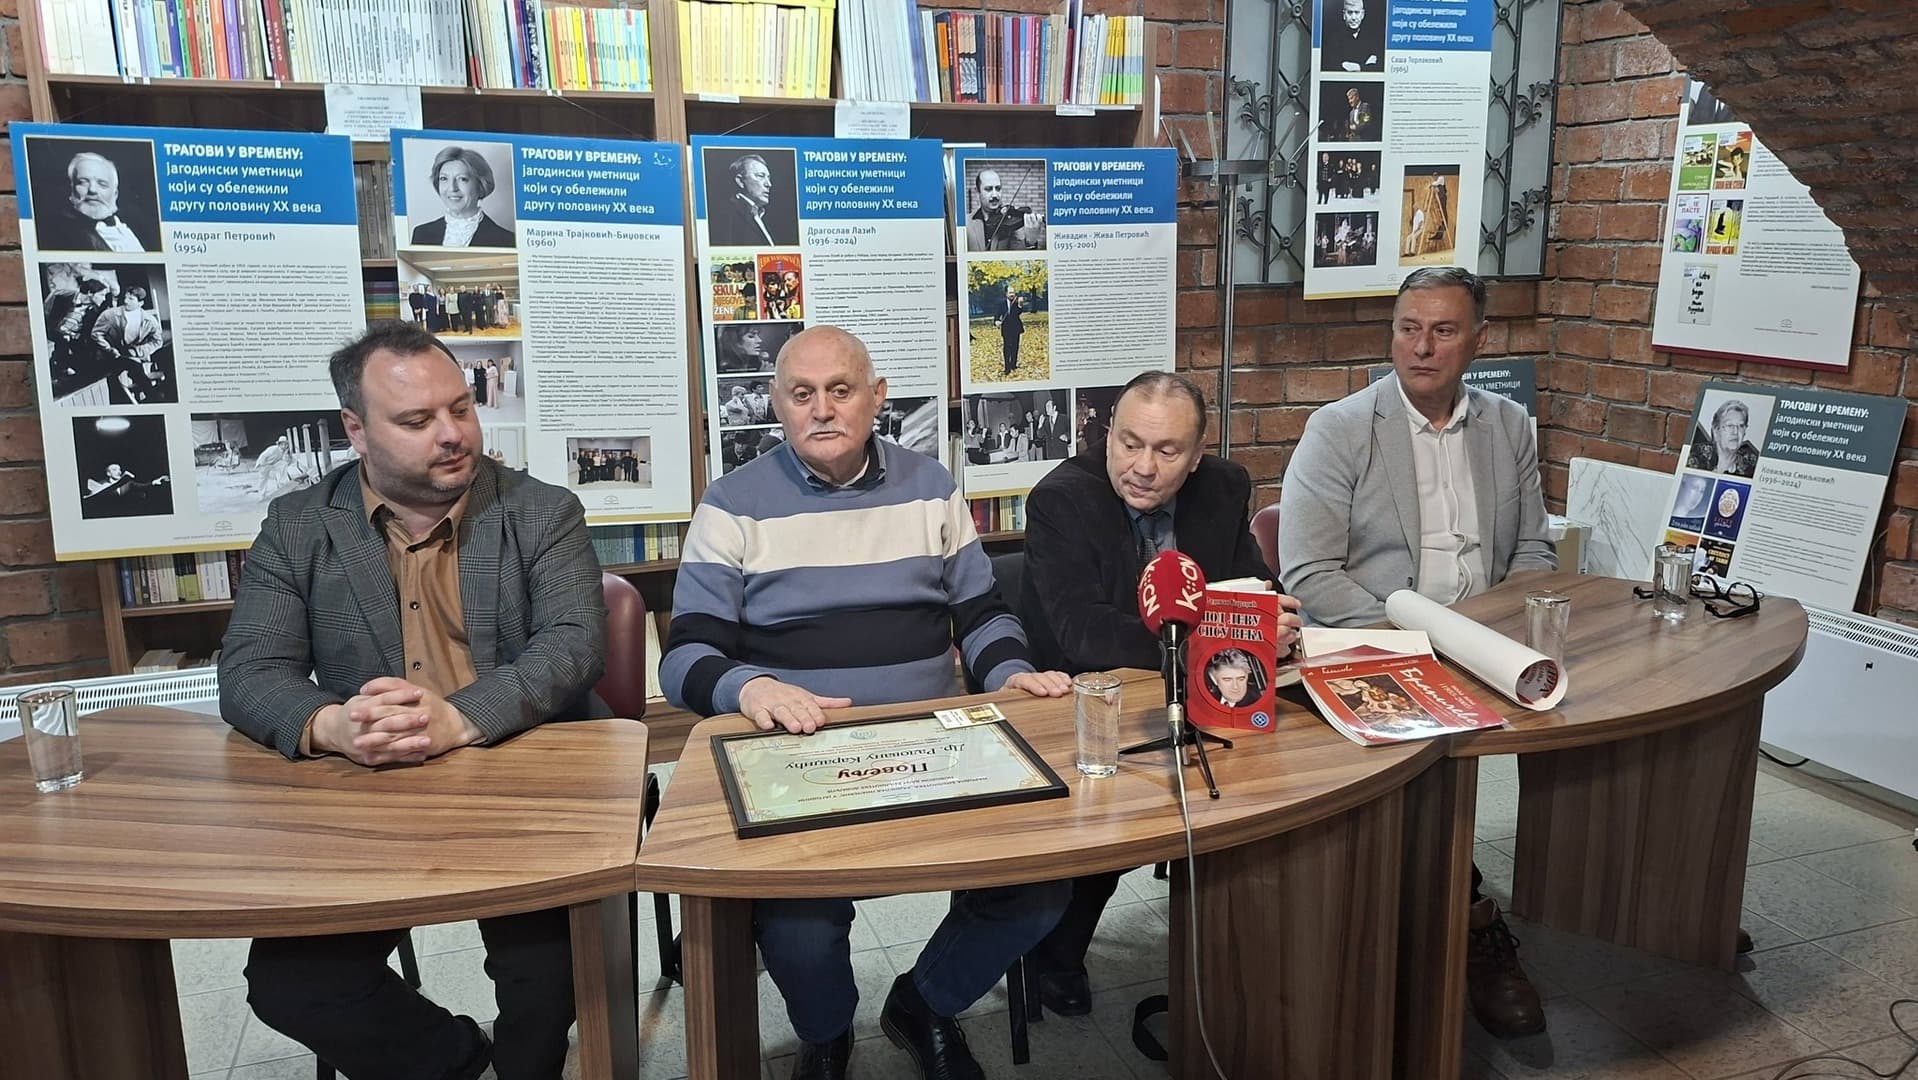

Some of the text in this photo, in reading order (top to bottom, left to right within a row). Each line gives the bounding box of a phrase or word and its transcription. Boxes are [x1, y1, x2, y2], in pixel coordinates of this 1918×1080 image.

[164, 144, 303, 159] ТРАГОВИ У ВРЕМЕНУ:
[521, 148, 641, 164] ТРАГОВИ У ВРЕМЕНУ:
[804, 152, 906, 162] ТРАГОВИ У ВРЕМЕНУ:
[167, 162, 303, 178] јагодински уметници
[523, 164, 639, 181] јагодински уметници
[1053, 162, 1144, 171] ТРАГОВИ У ВРЕМЕНУ:
[805, 168, 905, 179] јагодински уметници
[169, 181, 288, 194] који су обележили
[1054, 177, 1143, 187] јагодински уметници
[524, 184, 627, 196] који су обележили
[806, 183, 894, 195] који су обележили
[1054, 191, 1132, 202] који су обележили
[170, 201, 204, 213] другу
[209, 202, 270, 214] половину
[293, 203, 321, 212] века
[524, 201, 554, 212] другу
[558, 203, 610, 214] половину
[630, 205, 654, 214] века
[806, 200, 832, 211] другу
[835, 200, 880, 210] половину
[897, 200, 918, 208] века
[1053, 207, 1077, 217] другу
[1079, 207, 1119, 216] половину
[174, 231, 275, 242] Миодраг Петровић
[527, 228, 563, 238] Марина
[808, 227, 849, 236] Драгослав
[1054, 232, 1087, 240] Живадин
[1115, 231, 1149, 239] Петровић
[174, 243, 206, 254] (1954)
[527, 238, 556, 248] (1960)
[1479, 370, 1511, 379] ВРЕМЕНУ:
[1780, 400, 1869, 418] ТРАГОВИ У ВРЕМЕНУ:
[1776, 413, 1863, 432] јагодински уметници
[1773, 428, 1848, 445] који су обележили
[1768, 442, 1790, 452] другу
[1792, 445, 1832, 459] половину
[1846, 454, 1866, 462] века
[1231, 627, 1264, 641] ВЕКА
[867, 748, 936, 760] Радовану
[838, 762, 928, 779] Повељу
